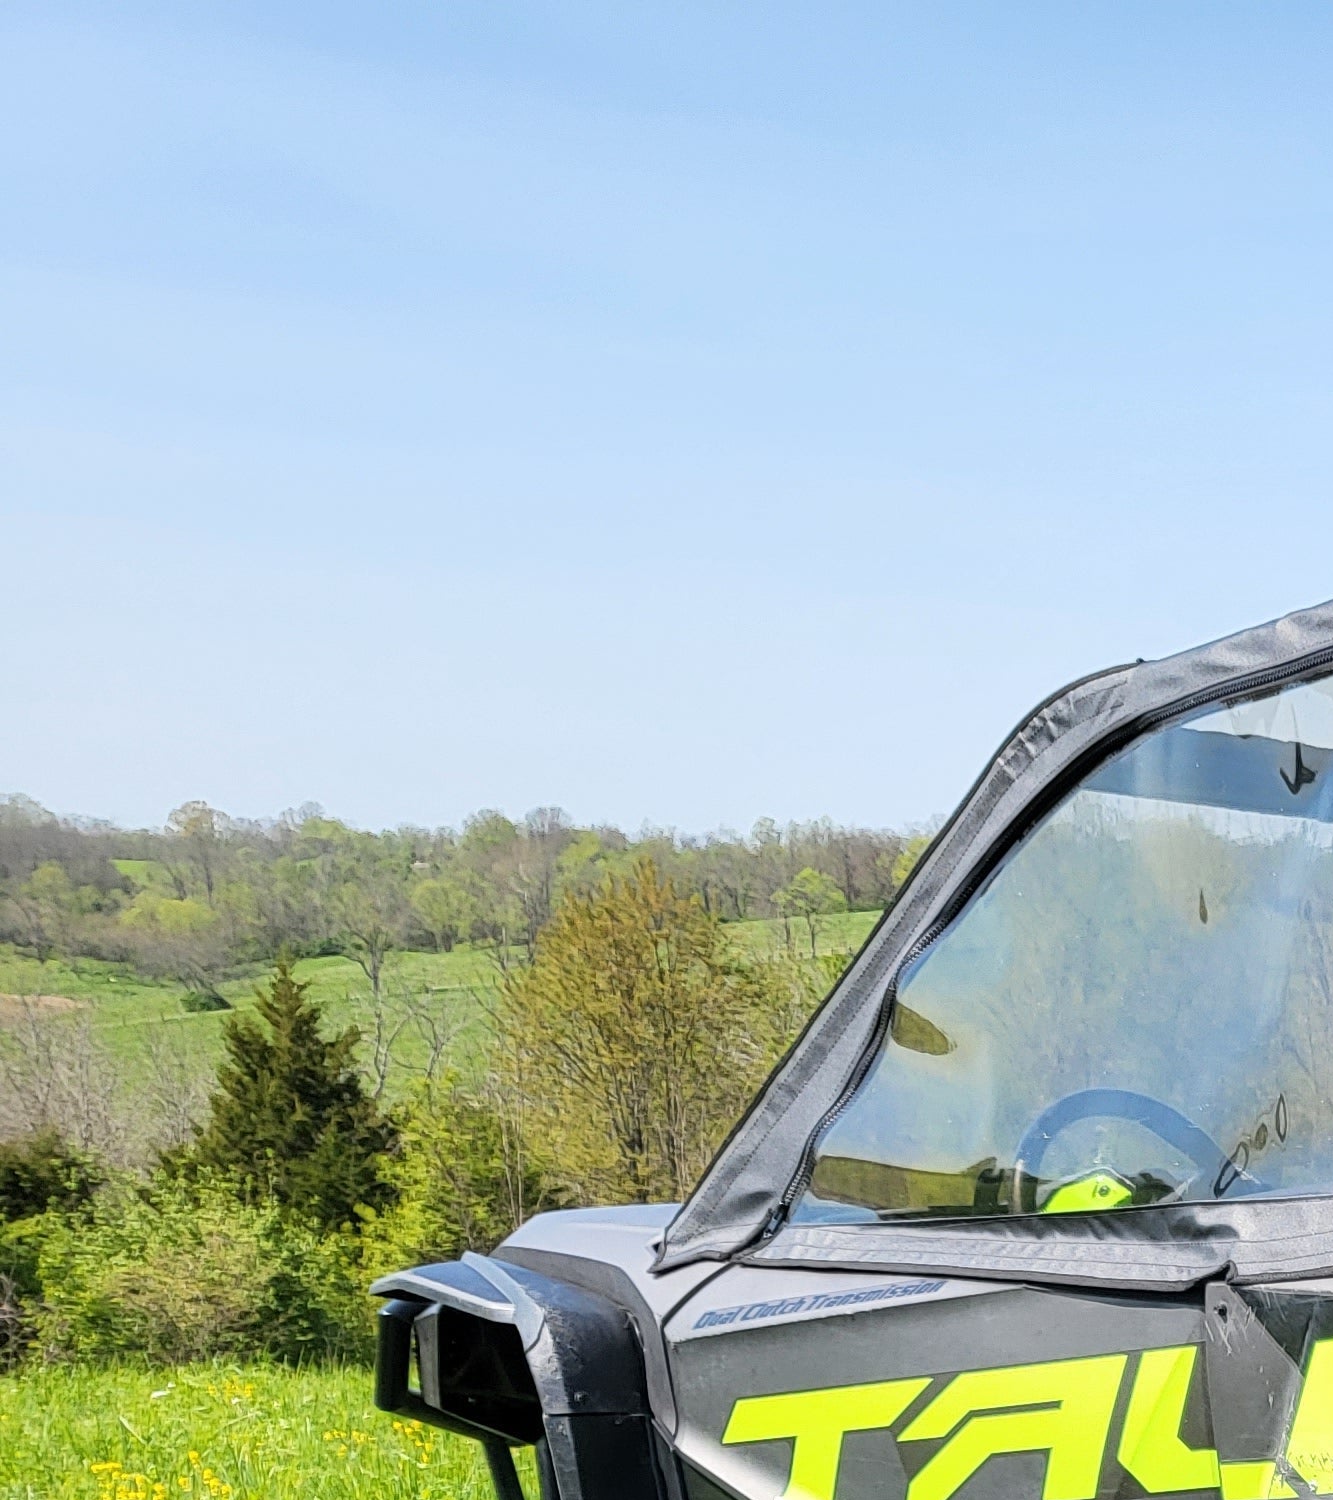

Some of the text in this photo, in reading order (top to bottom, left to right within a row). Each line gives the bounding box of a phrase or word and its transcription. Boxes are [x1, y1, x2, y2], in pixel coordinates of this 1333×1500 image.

[692, 1279, 949, 1331] Dual Clutch Transmission
